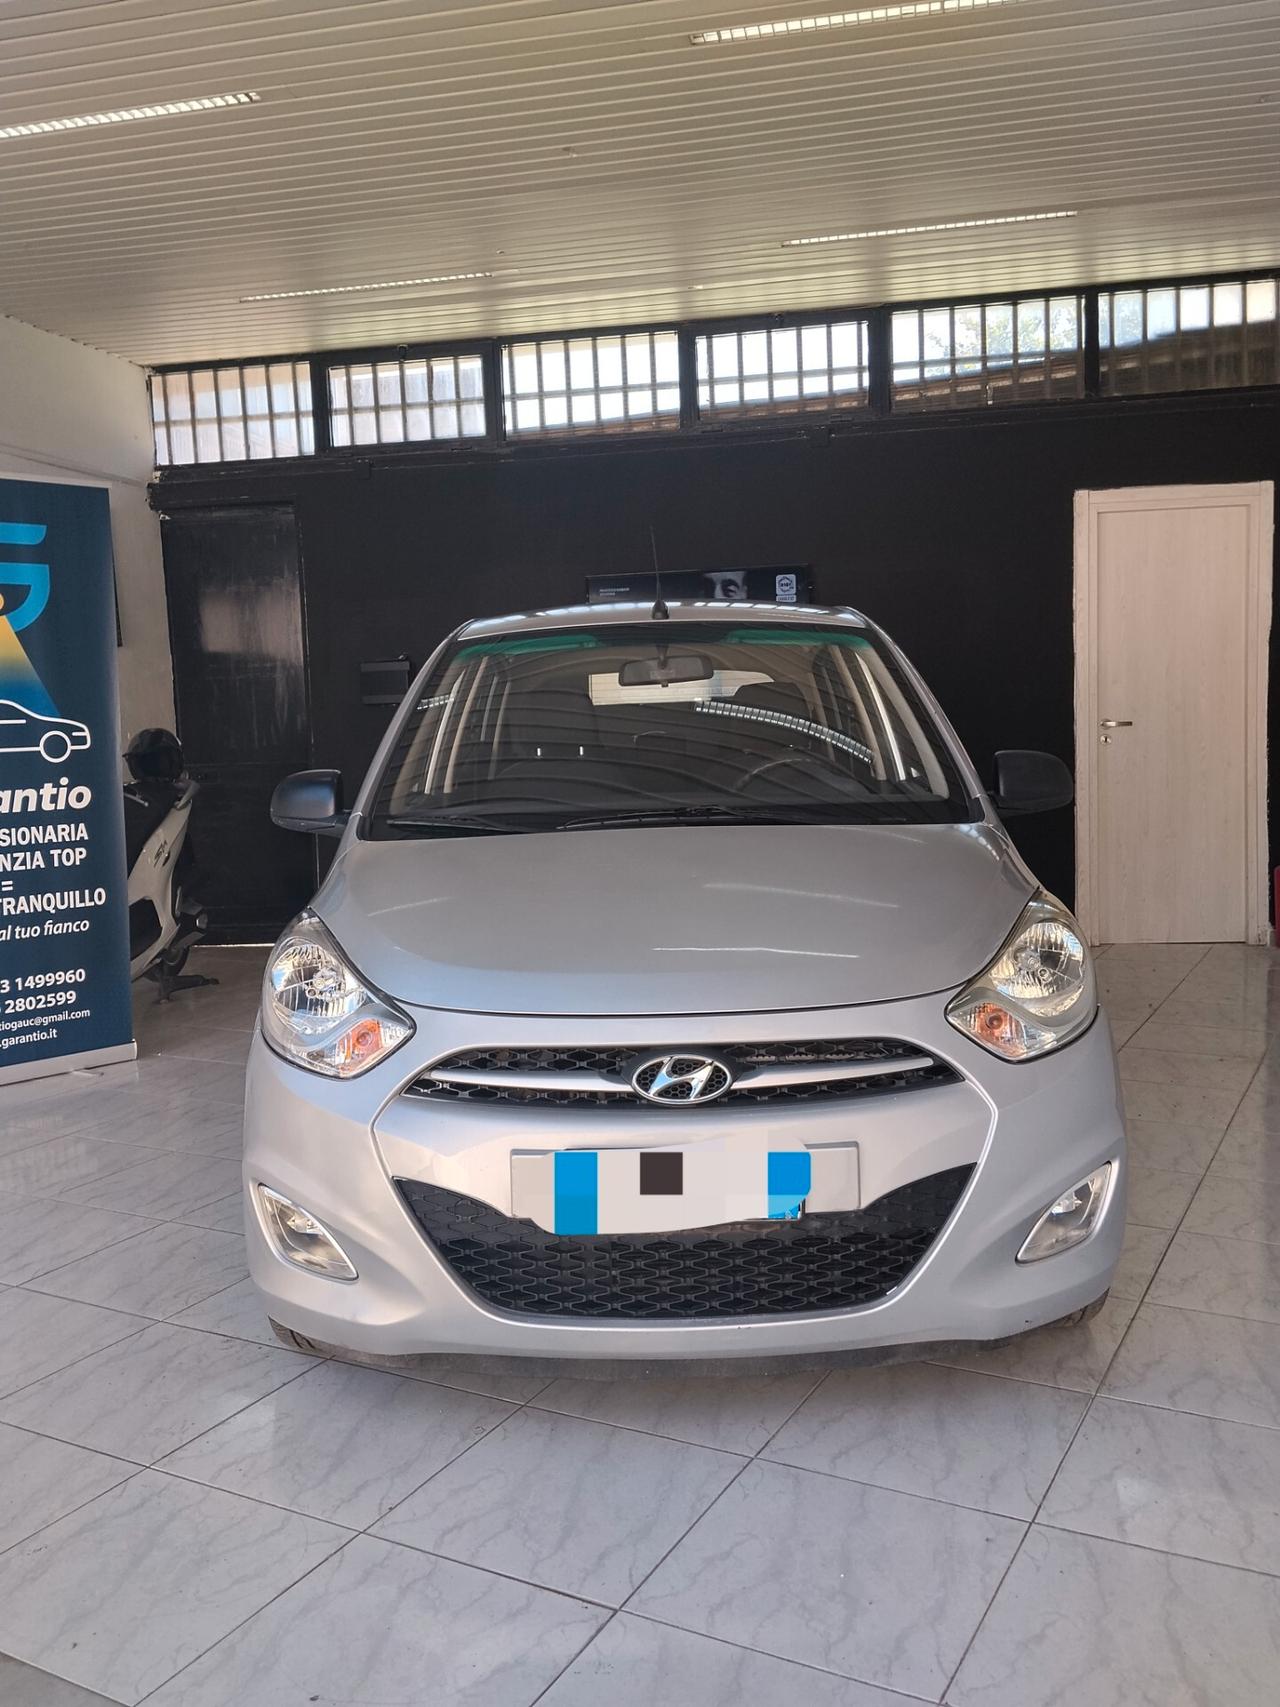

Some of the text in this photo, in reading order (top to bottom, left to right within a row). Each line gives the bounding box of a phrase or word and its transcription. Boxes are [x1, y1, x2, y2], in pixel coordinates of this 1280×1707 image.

[0, 823, 89, 847] SIONARIA
[0, 847, 87, 872] NZIA TOP
[0, 887, 106, 916] RANQUILLO
[15, 926, 41, 939] tuo
[44, 920, 90, 936] fianco
[0, 968, 86, 993] 3 1499960
[5, 991, 77, 1014] 2802599
